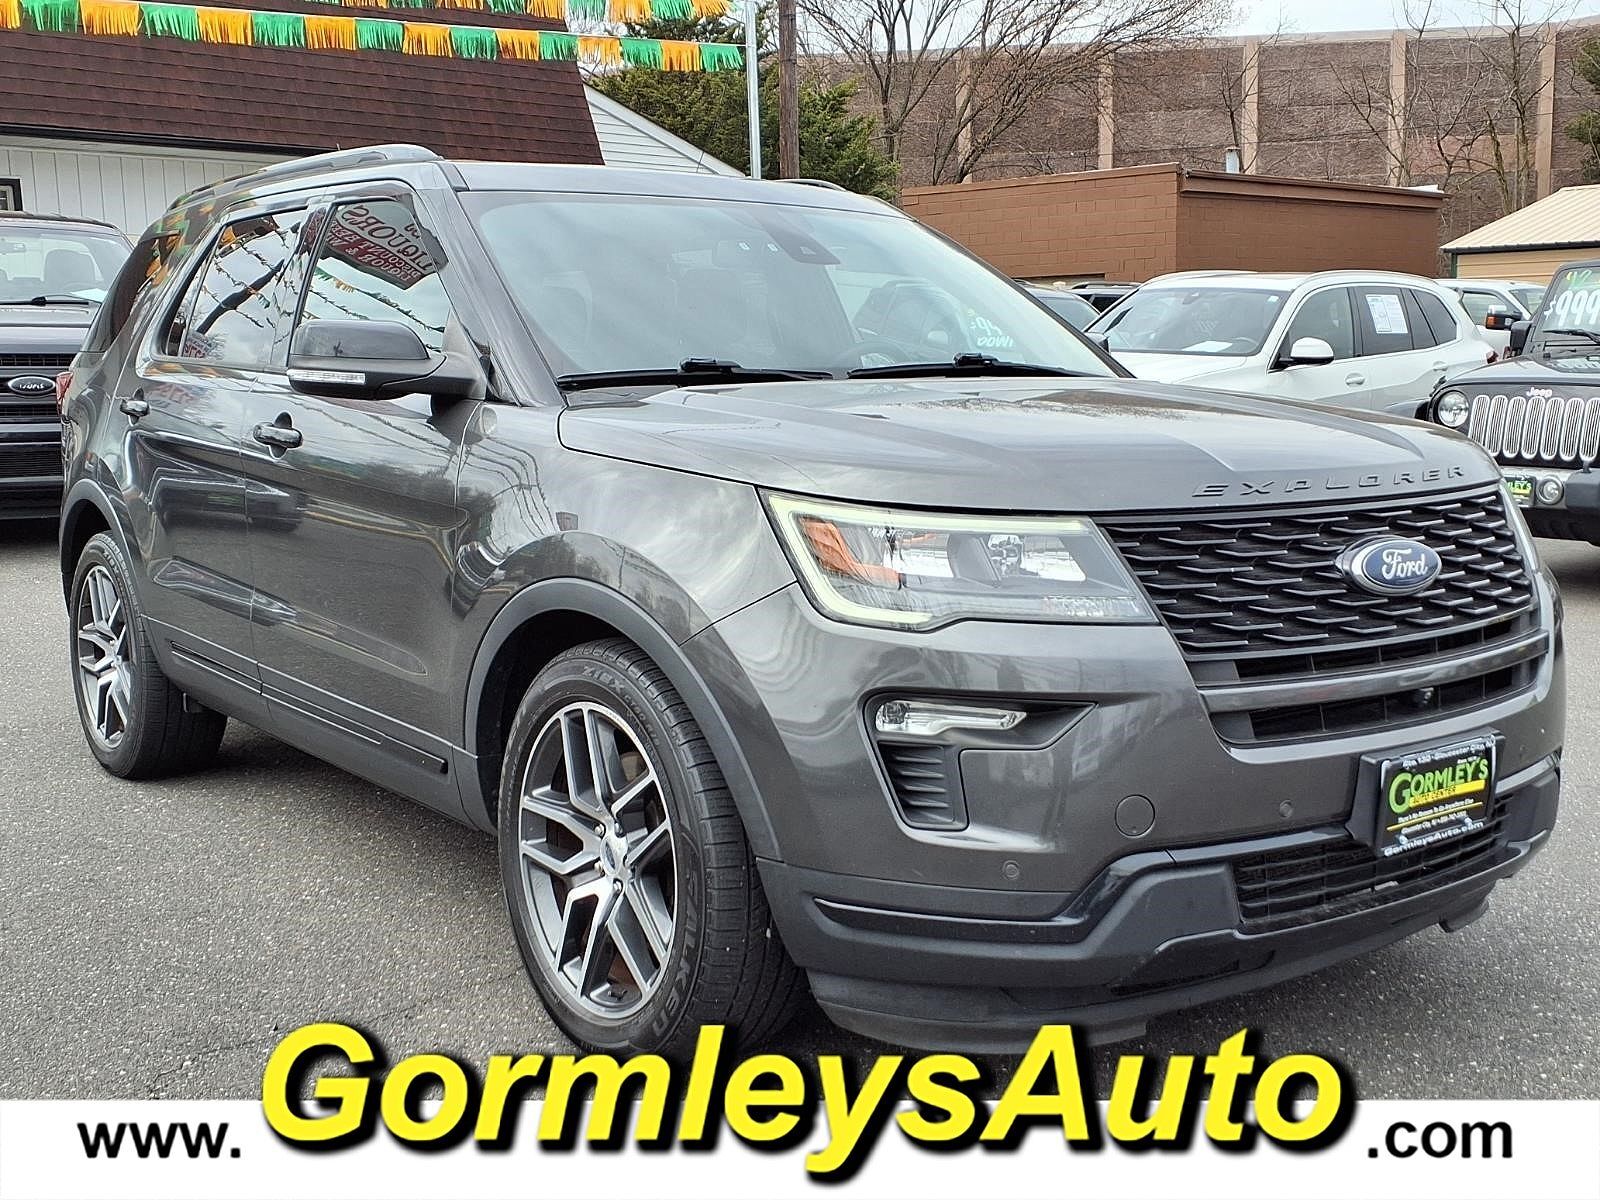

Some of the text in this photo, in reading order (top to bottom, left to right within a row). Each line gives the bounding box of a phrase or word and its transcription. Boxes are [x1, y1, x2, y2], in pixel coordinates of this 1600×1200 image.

[1526, 387, 1553, 398] Jeep
[1191, 465, 1465, 498] EXPLORER
[1381, 548, 1429, 581] Ford
[1389, 758, 1489, 814] GORMLEY'S
